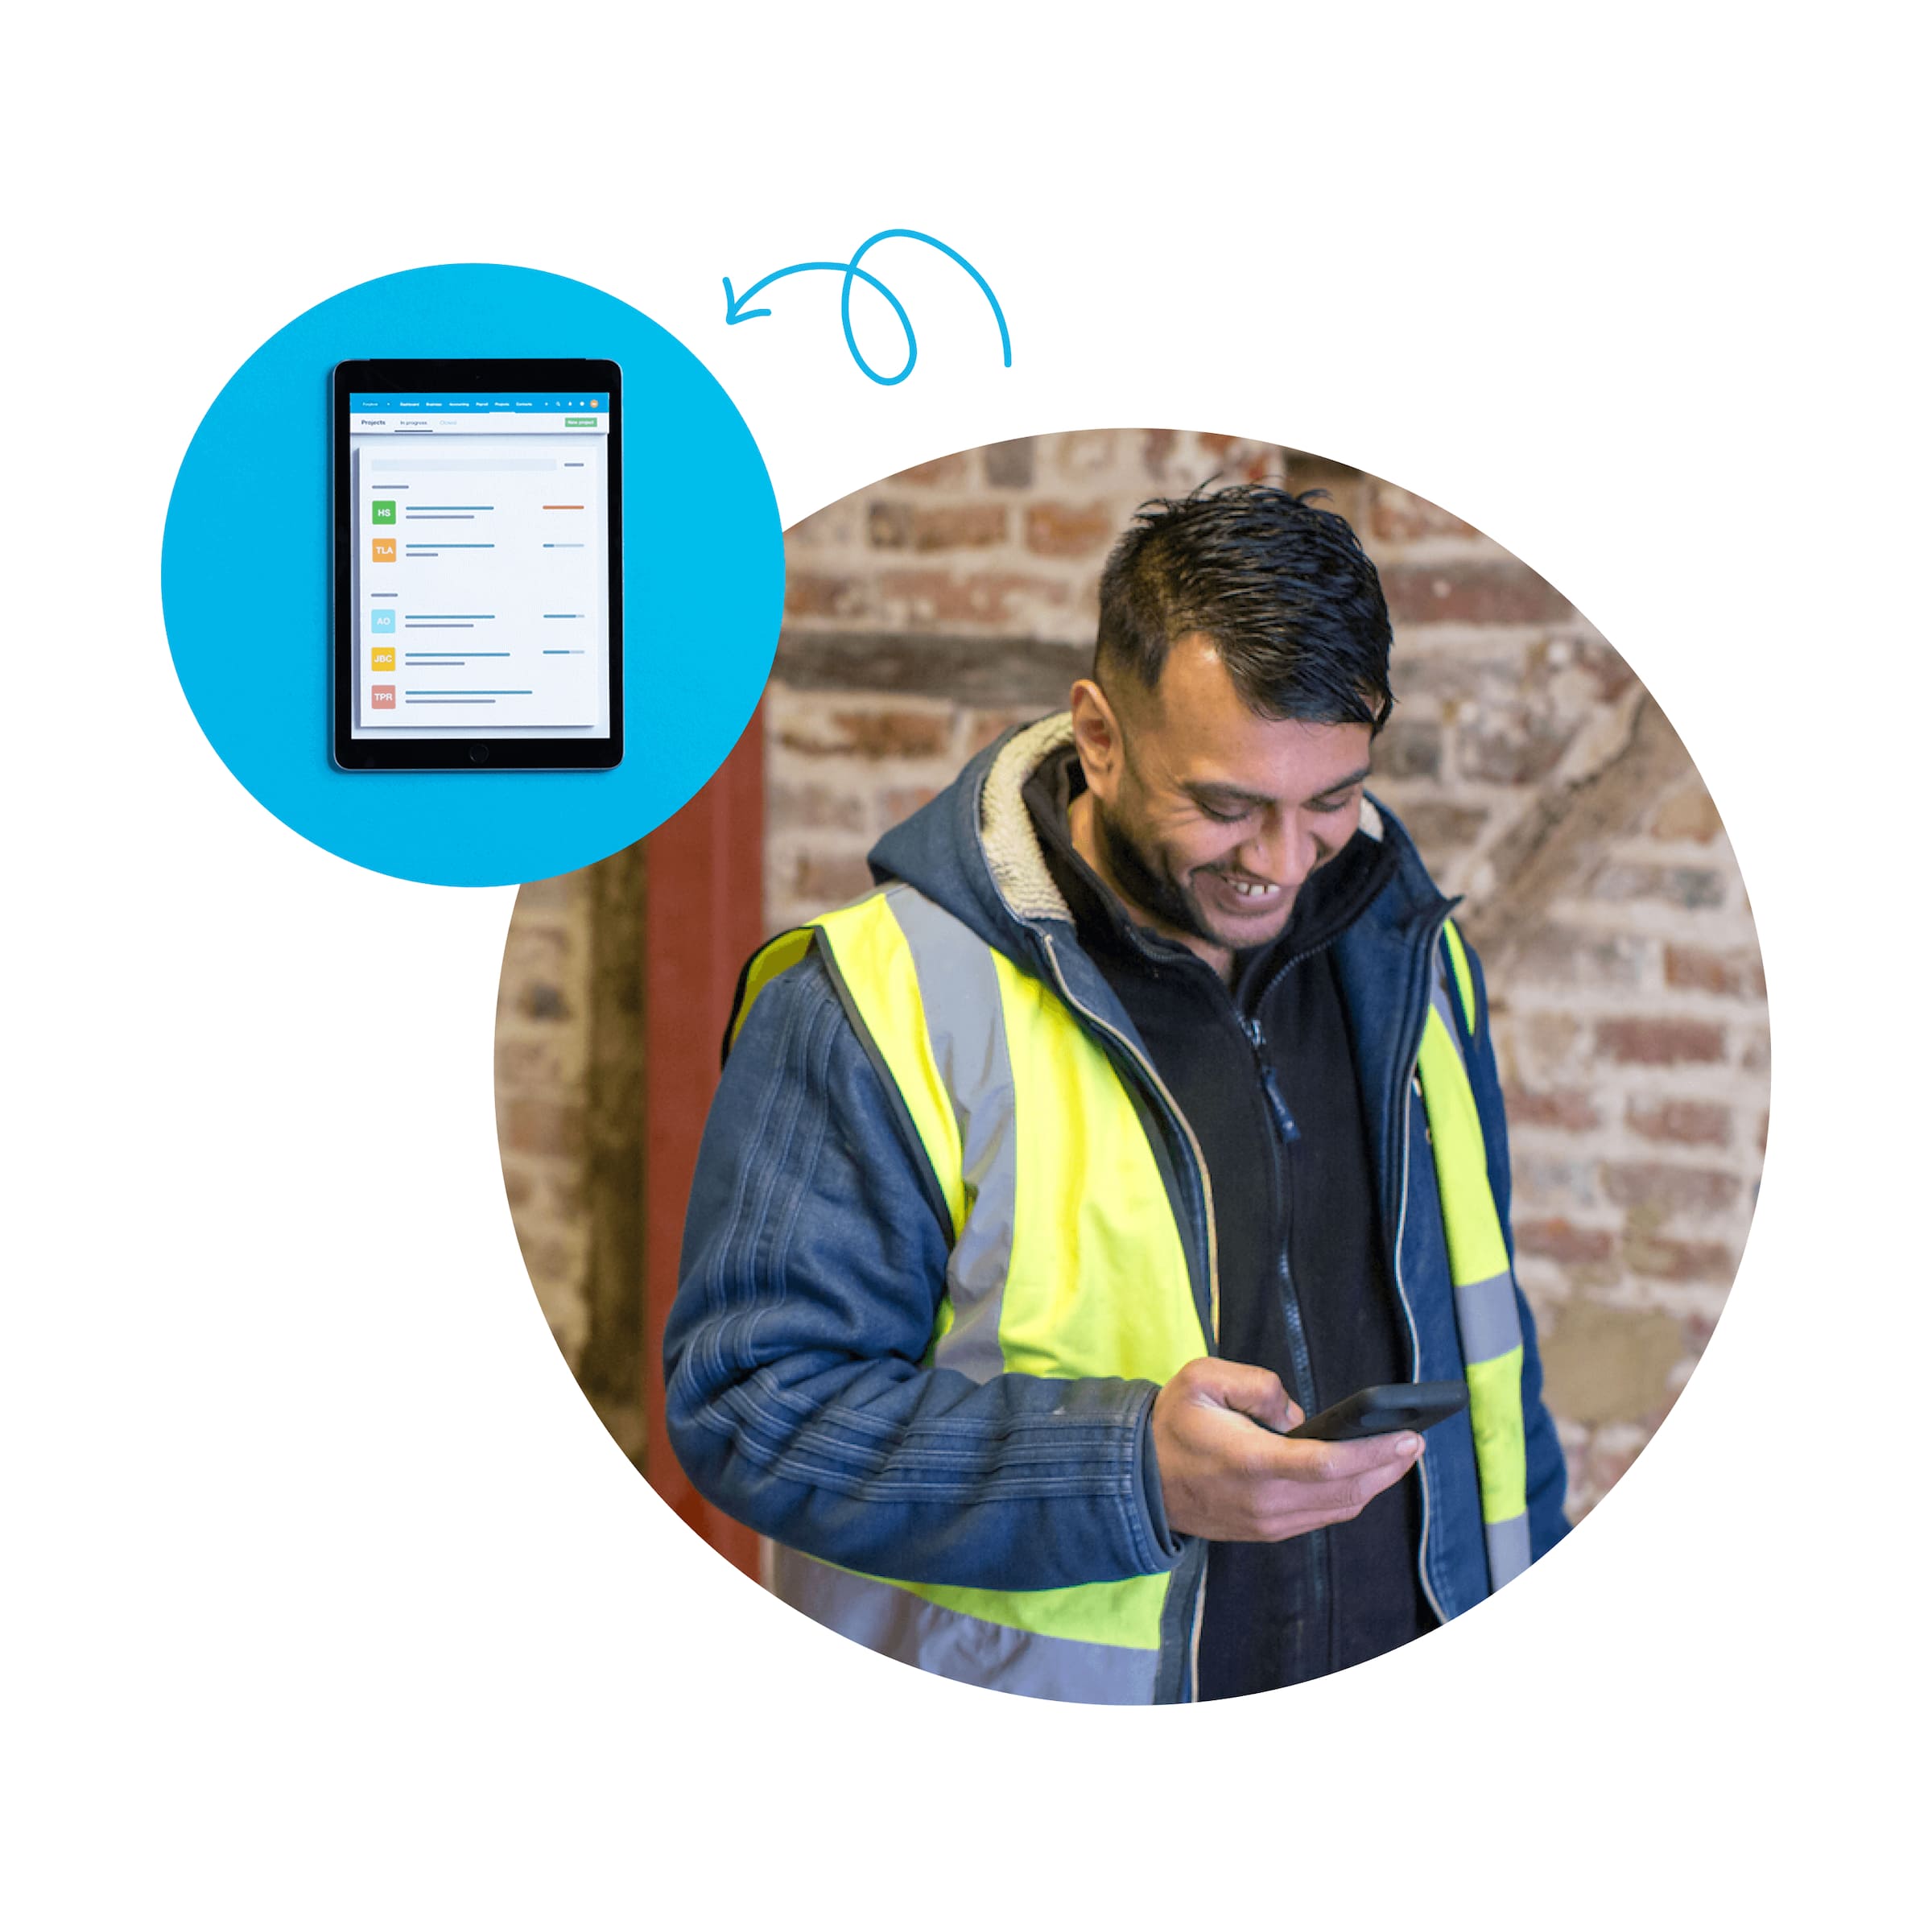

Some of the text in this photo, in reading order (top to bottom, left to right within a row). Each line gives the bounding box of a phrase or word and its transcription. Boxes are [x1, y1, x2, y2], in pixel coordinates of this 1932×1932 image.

[361, 419, 386, 427] Projects
[378, 508, 391, 517] HS
[375, 546, 394, 555] TLA
[376, 617, 391, 625] AO
[374, 654, 393, 663] JBC
[374, 692, 393, 701] TPR
